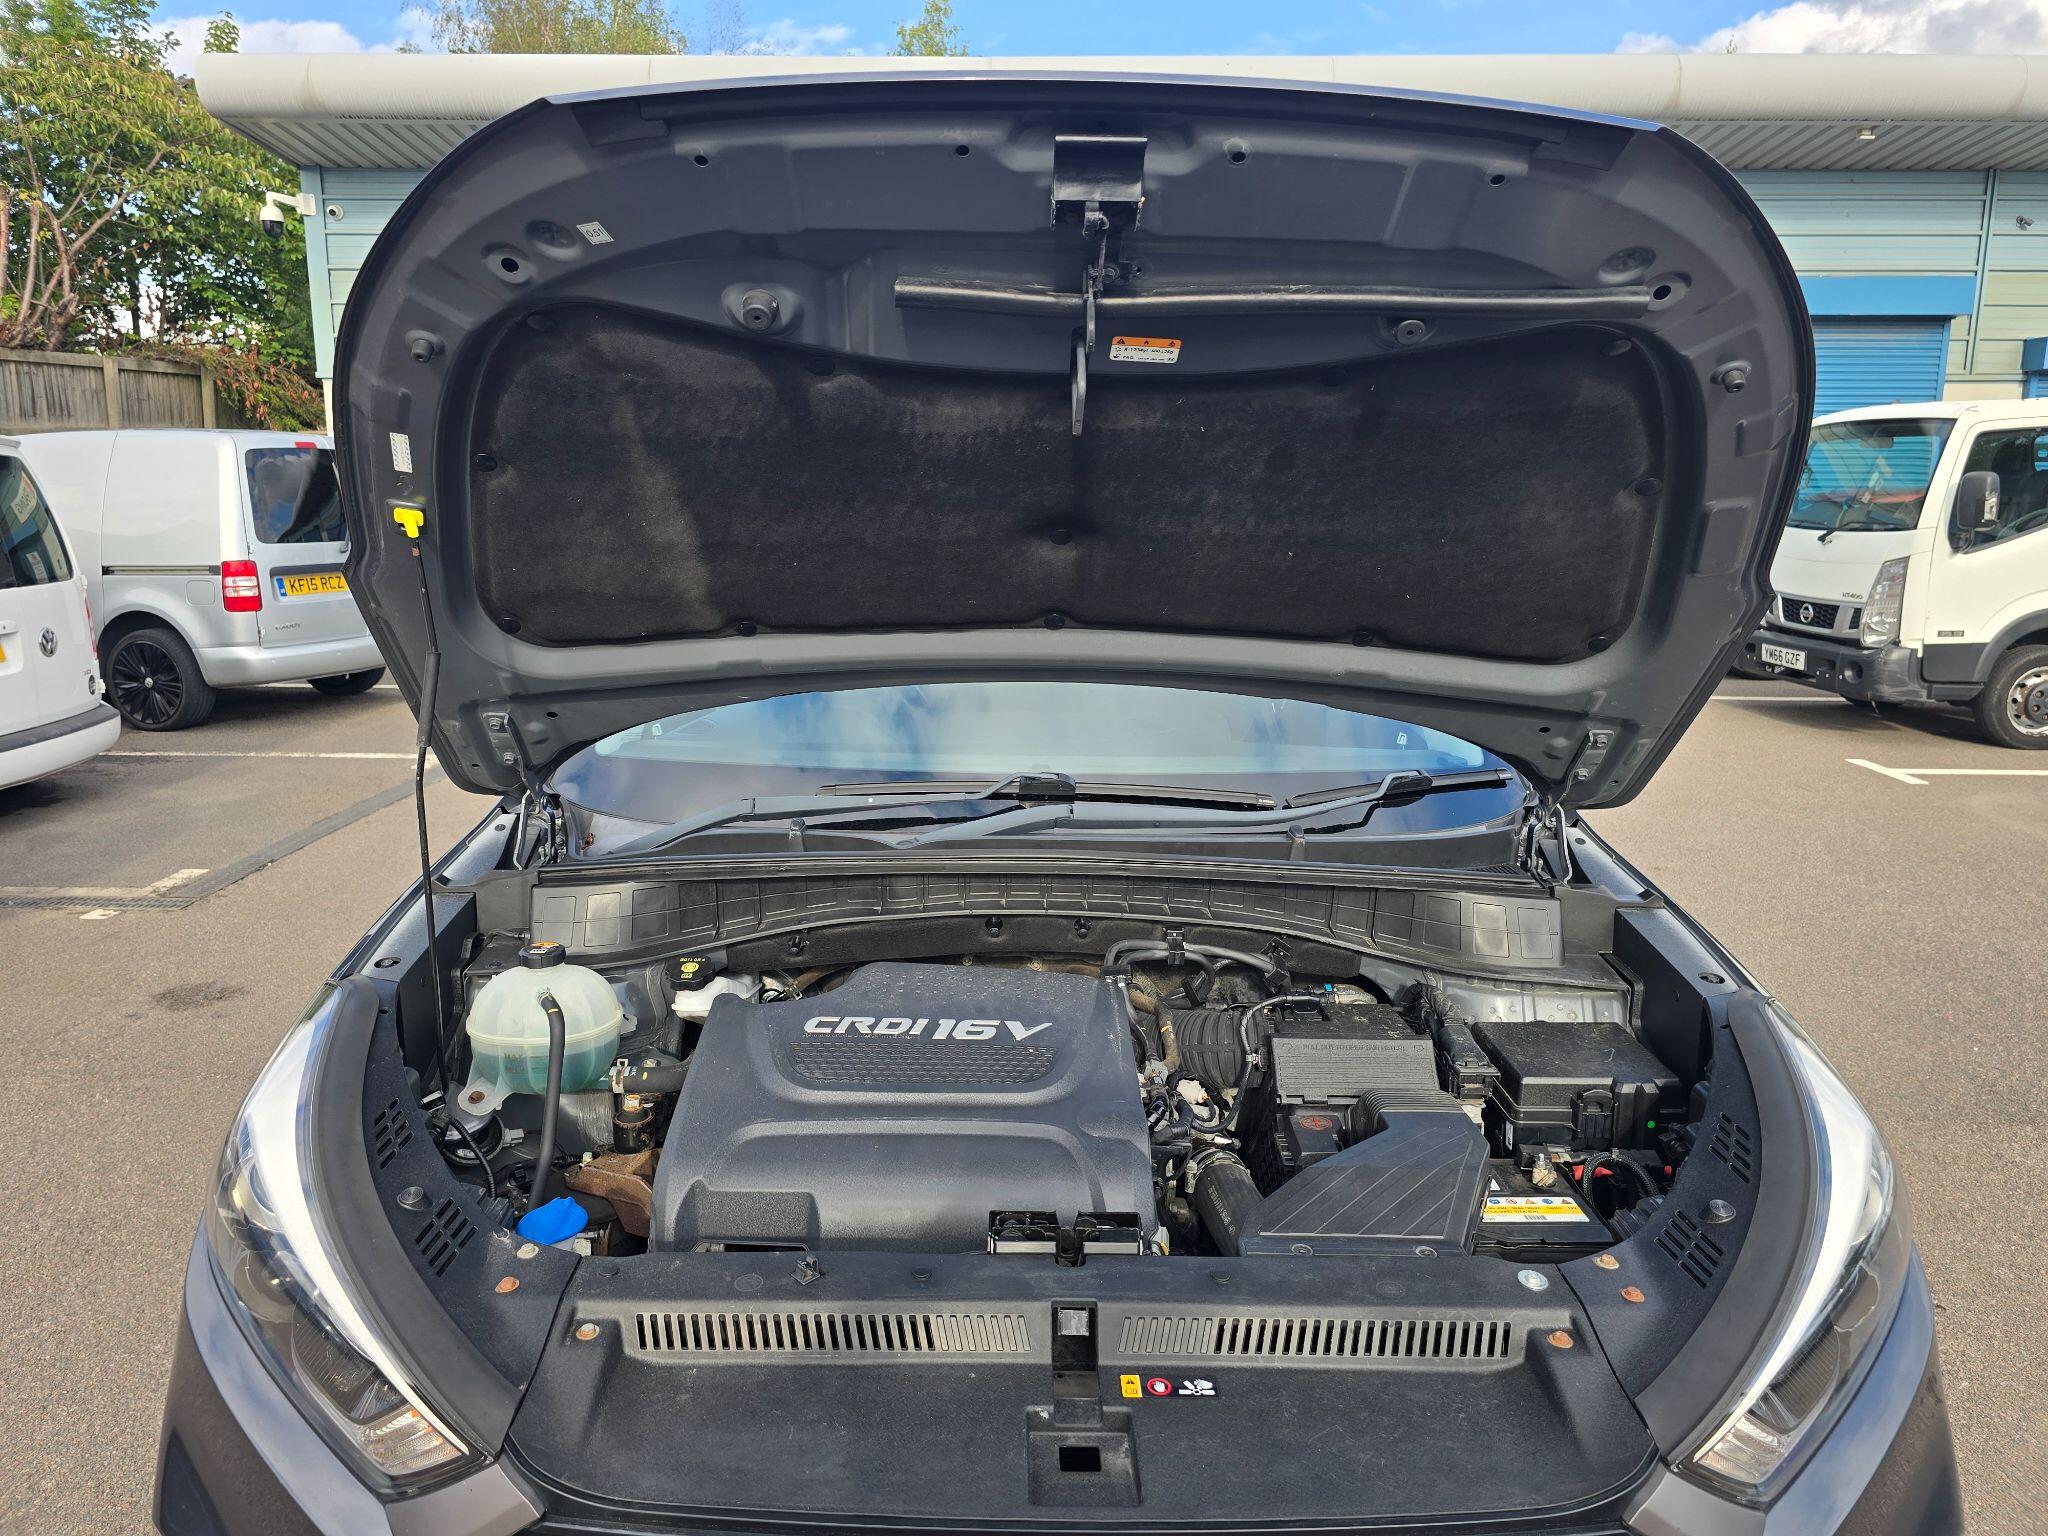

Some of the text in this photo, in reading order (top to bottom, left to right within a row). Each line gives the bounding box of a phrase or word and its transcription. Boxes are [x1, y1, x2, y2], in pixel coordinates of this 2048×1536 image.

[288, 575, 344, 593] KF15 RCZ
[1785, 651, 1800, 666] GZF
[803, 1016, 930, 1036] CRDI
